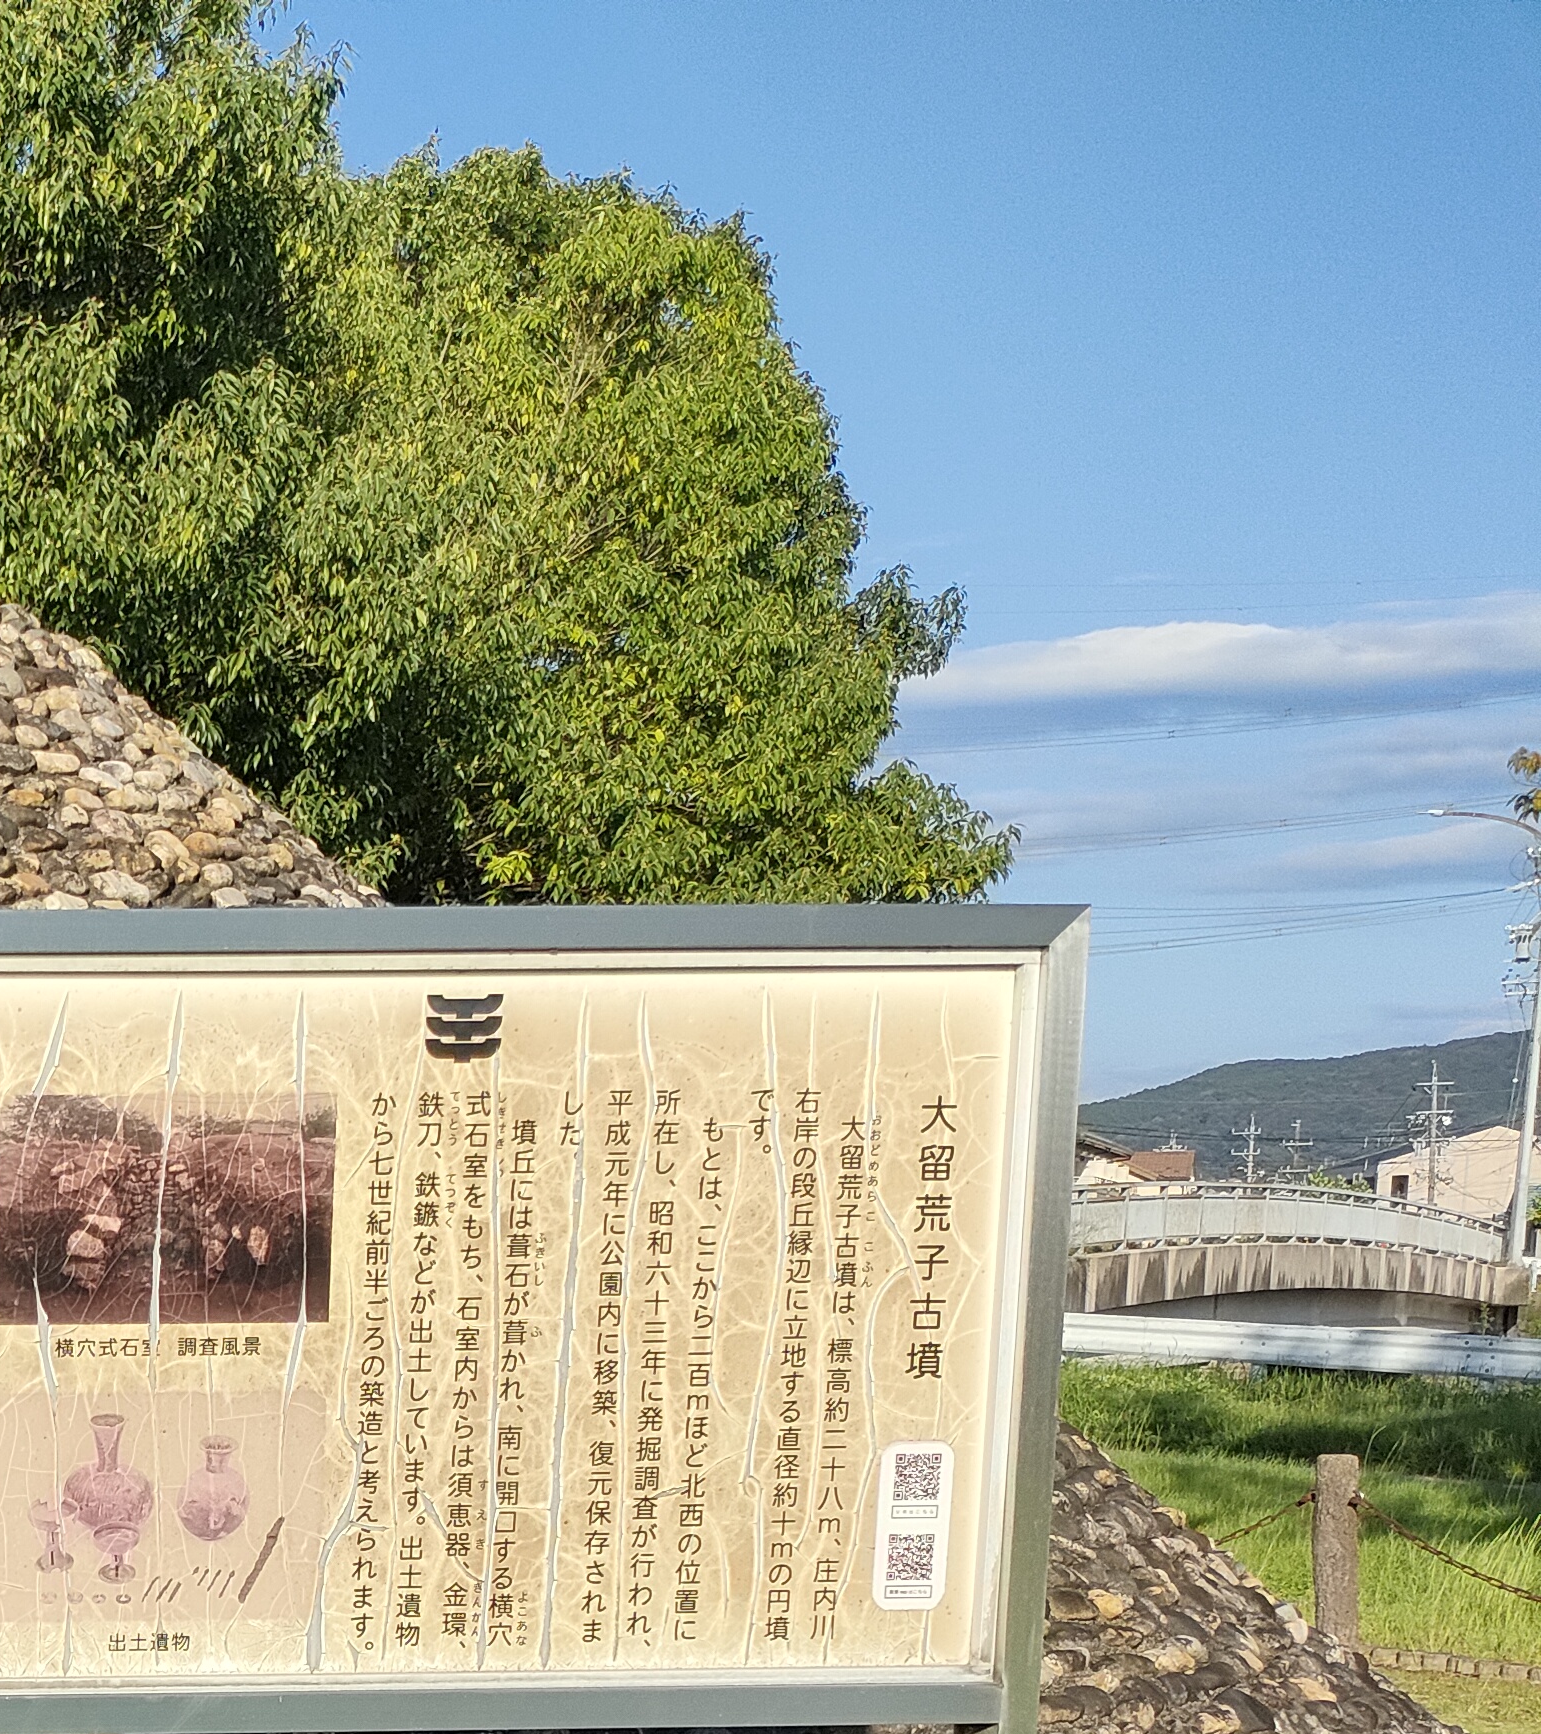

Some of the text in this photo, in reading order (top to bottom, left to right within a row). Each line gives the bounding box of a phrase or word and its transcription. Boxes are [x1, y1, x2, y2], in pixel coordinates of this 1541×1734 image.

[749, 1089, 774, 1154] です。
[905, 1095, 957, 1379] 大留荒子古墳
[177, 1337, 262, 1357] 調査風景
[108, 1632, 191, 1652] 出土遺物
